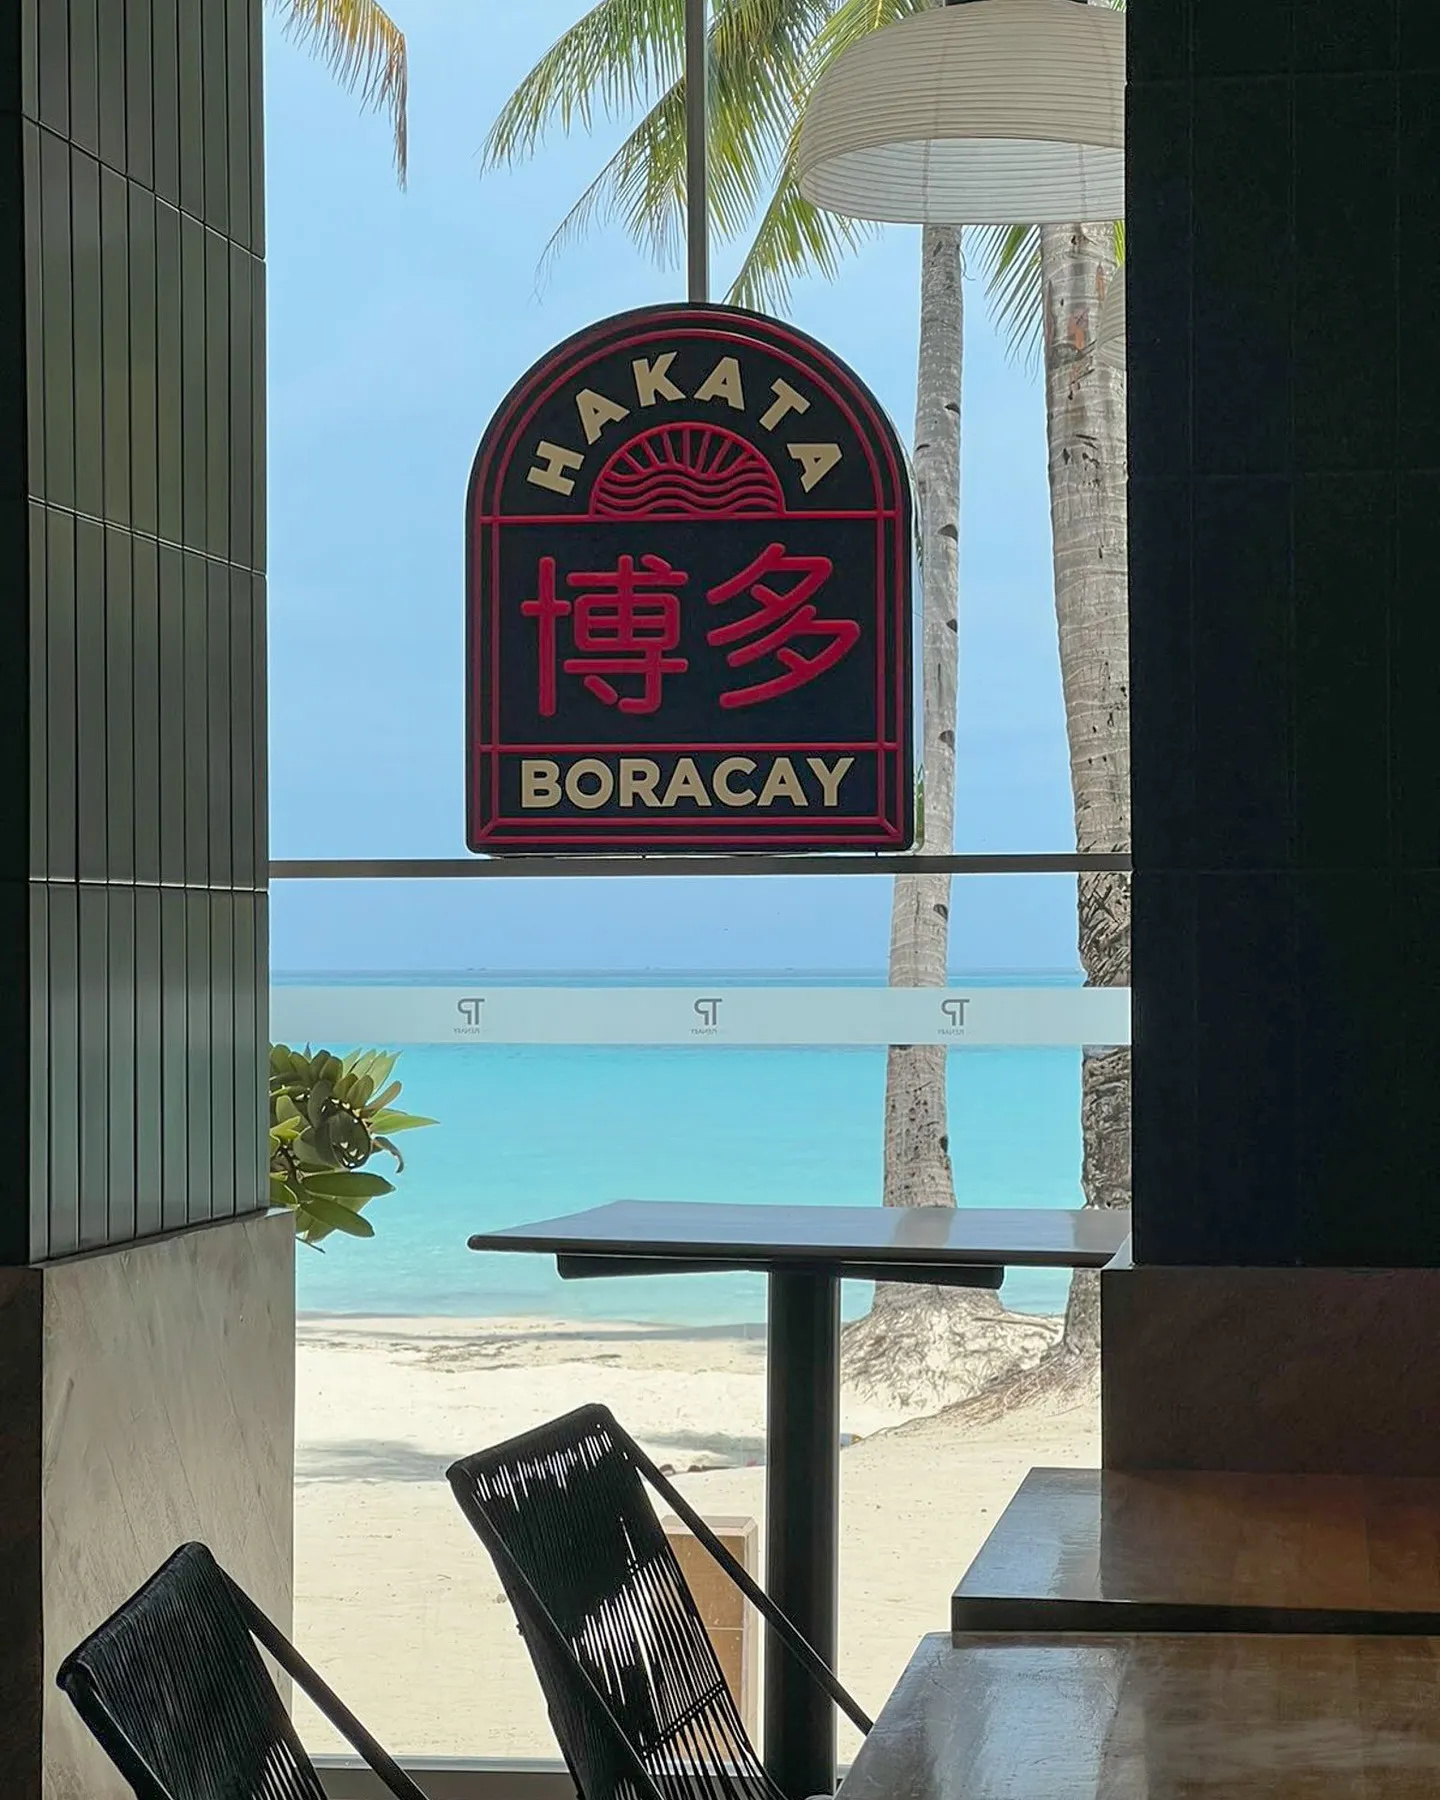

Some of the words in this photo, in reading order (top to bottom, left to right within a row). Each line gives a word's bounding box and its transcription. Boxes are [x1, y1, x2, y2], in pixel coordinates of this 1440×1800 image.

[526, 350, 843, 497] HAKATA
[519, 541, 862, 718] 博多
[520, 756, 855, 810] BORACAY
